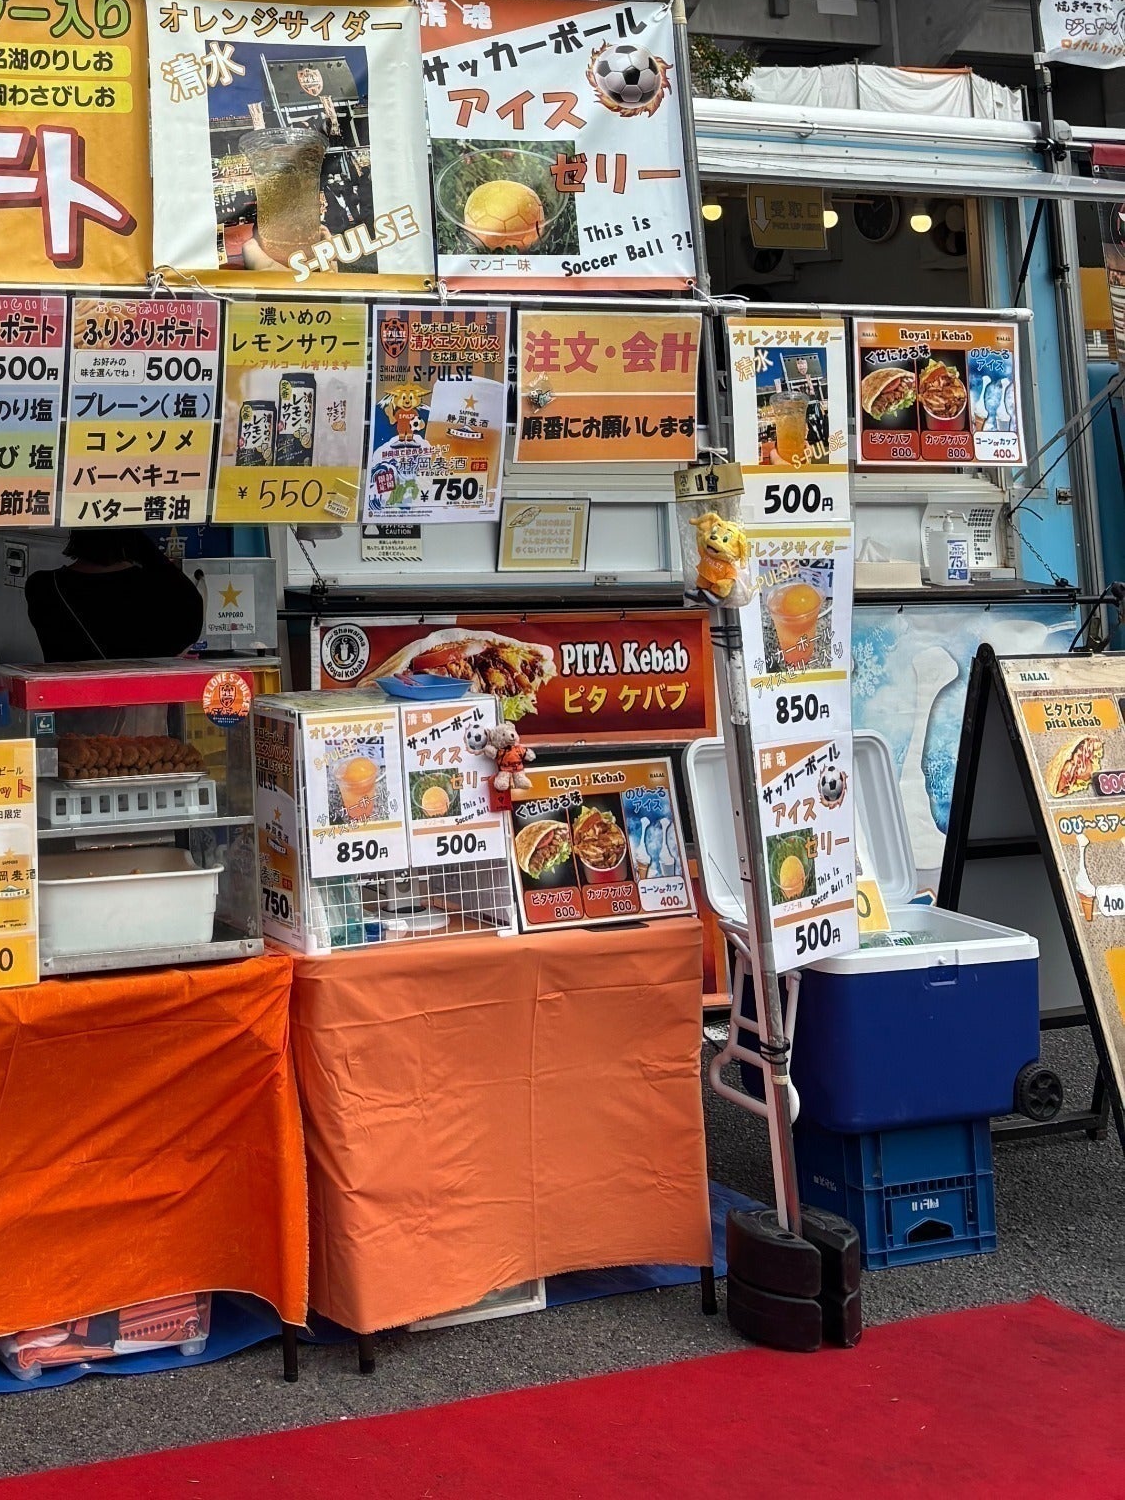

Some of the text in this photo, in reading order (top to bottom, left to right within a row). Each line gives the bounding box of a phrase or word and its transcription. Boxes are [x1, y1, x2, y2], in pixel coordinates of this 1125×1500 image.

[158, 1, 403, 42] オレンジサイダー
[423, 6, 647, 86] サッカーボール
[161, 41, 246, 103] 清水
[448, 88, 588, 130] アイス
[549, 152, 681, 195] ゼリー
[583, 215, 652, 243] This is
[288, 204, 420, 284] S-PULSE
[469, 258, 532, 272] マンゴー味
[561, 238, 664, 278] Soccer Ball
[259, 306, 332, 327] 濃いめの
[82, 316, 211, 348] ふりふりポテト
[231, 333, 361, 356] レモンサワー
[410, 335, 501, 351] 清水エスパルス
[733, 329, 843, 347] オレンジサイダー
[900, 329, 973, 342] Royal Kebab
[92, 356, 127, 367] お好みの
[524, 329, 697, 374] 注文・会計
[864, 343, 931, 365] くせになる味
[80, 367, 136, 379] 味を選んでね!
[145, 357, 213, 381] 500円
[380, 365, 411, 373] SHIZUOKA
[380, 365, 474, 382] SHIMIZU S-PULSE
[734, 348, 774, 383] 清水
[976, 359, 1006, 372] アイス
[75, 393, 211, 420] プレーン(塩)
[292, 394, 303, 427] レモン
[521, 414, 697, 441] 順番にお願いします
[86, 429, 195, 453] コンソメ
[791, 429, 848, 470] S-PULSE
[73, 464, 202, 487] バーベキュー
[763, 483, 834, 515] 500円
[385, 528, 413, 536] CAUTION
[217, 611, 245, 619] SAPPORO
[560, 641, 689, 675] PITA Kebab
[1019, 672, 1051, 682] HALAL
[203, 673, 227, 708] WE LOVE
[563, 681, 691, 714] ピタ ケバブ
[775, 693, 831, 725] 850円
[308, 723, 394, 740] オレンジサイダー
[406, 707, 484, 750] サッカーボール
[1044, 716, 1102, 731] pita kebab
[416, 746, 463, 767] アイス
[450, 770, 492, 790] ゼリー
[548, 771, 625, 788] Royal Kebab
[762, 743, 841, 805] サッカーボール
[516, 790, 583, 819] くせになる味
[632, 799, 663, 813] アイス
[771, 797, 818, 828] アイス
[336, 838, 389, 863] 850円
[436, 833, 487, 857] 500円
[804, 830, 850, 860] ゼリー
[817, 873, 832, 887] This
[262, 888, 290, 918] 750
[1103, 894, 1125, 912] 400
[795, 917, 841, 956] 500円
